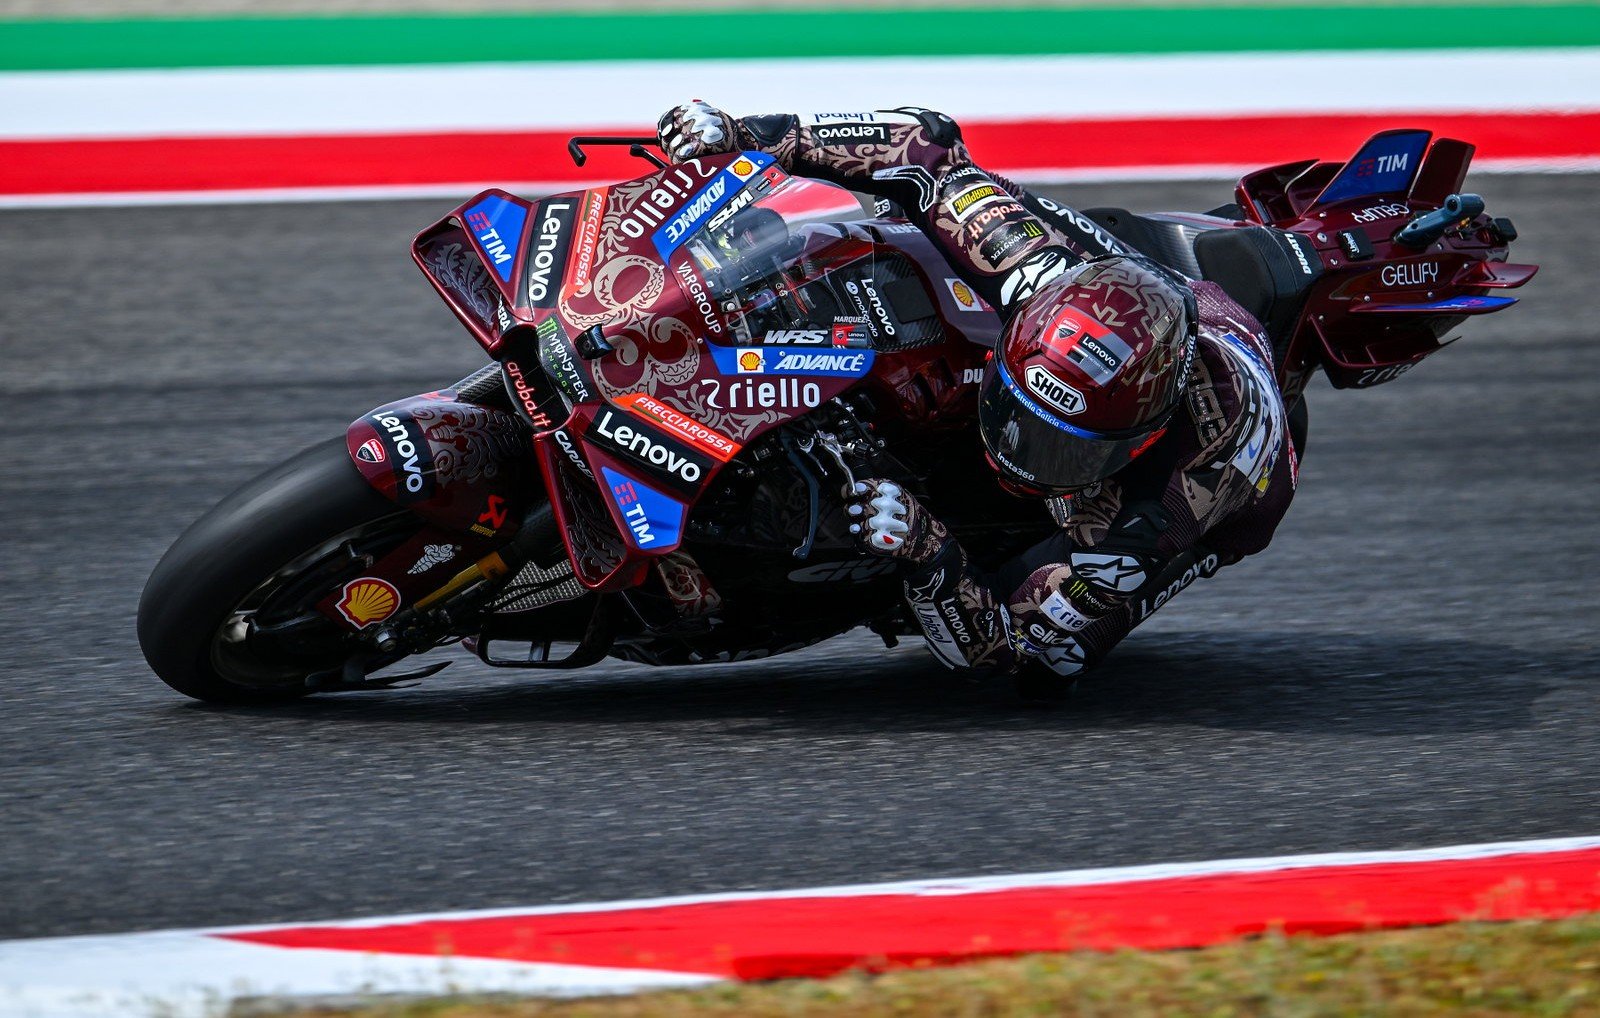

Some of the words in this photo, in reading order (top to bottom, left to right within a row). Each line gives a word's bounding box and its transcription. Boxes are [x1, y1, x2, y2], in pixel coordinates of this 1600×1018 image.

[818, 126, 885, 139] Lenovo
[1377, 153, 1409, 174] TIM
[621, 169, 694, 239] riello
[664, 175, 726, 244] ADVANCE
[707, 188, 754, 233] WRS
[1037, 197, 1123, 255] novo
[1350, 202, 1411, 224] GELLIFY
[480, 227, 512, 265] TIM
[529, 203, 570, 301] Lenovo
[575, 191, 602, 287] FRECCIAROSSA
[1285, 232, 1313, 275] DUCATI
[676, 260, 722, 334] VARGROUP
[1381, 262, 1439, 287] GELLIFY
[860, 277, 896, 337] Lenovo
[763, 329, 829, 344] WRS
[1082, 336, 1116, 367] Lenovo
[547, 331, 589, 403] MONSTER
[773, 353, 864, 372] ADVANCE
[507, 361, 553, 428] aruba.it
[729, 378, 821, 408] riello
[1013, 389, 1037, 413] Estrella
[1035, 408, 1060, 428] Galicia
[1030, 371, 1080, 412] SHOEI
[597, 411, 701, 483] Lenovo
[635, 396, 734, 454] FRECCIAROSSA
[371, 410, 424, 493] Lenovo
[626, 503, 656, 545] TIM
[1140, 553, 1218, 620] Lenovo
[940, 597, 972, 645] Lenovo
[1058, 608, 1091, 630] riel
